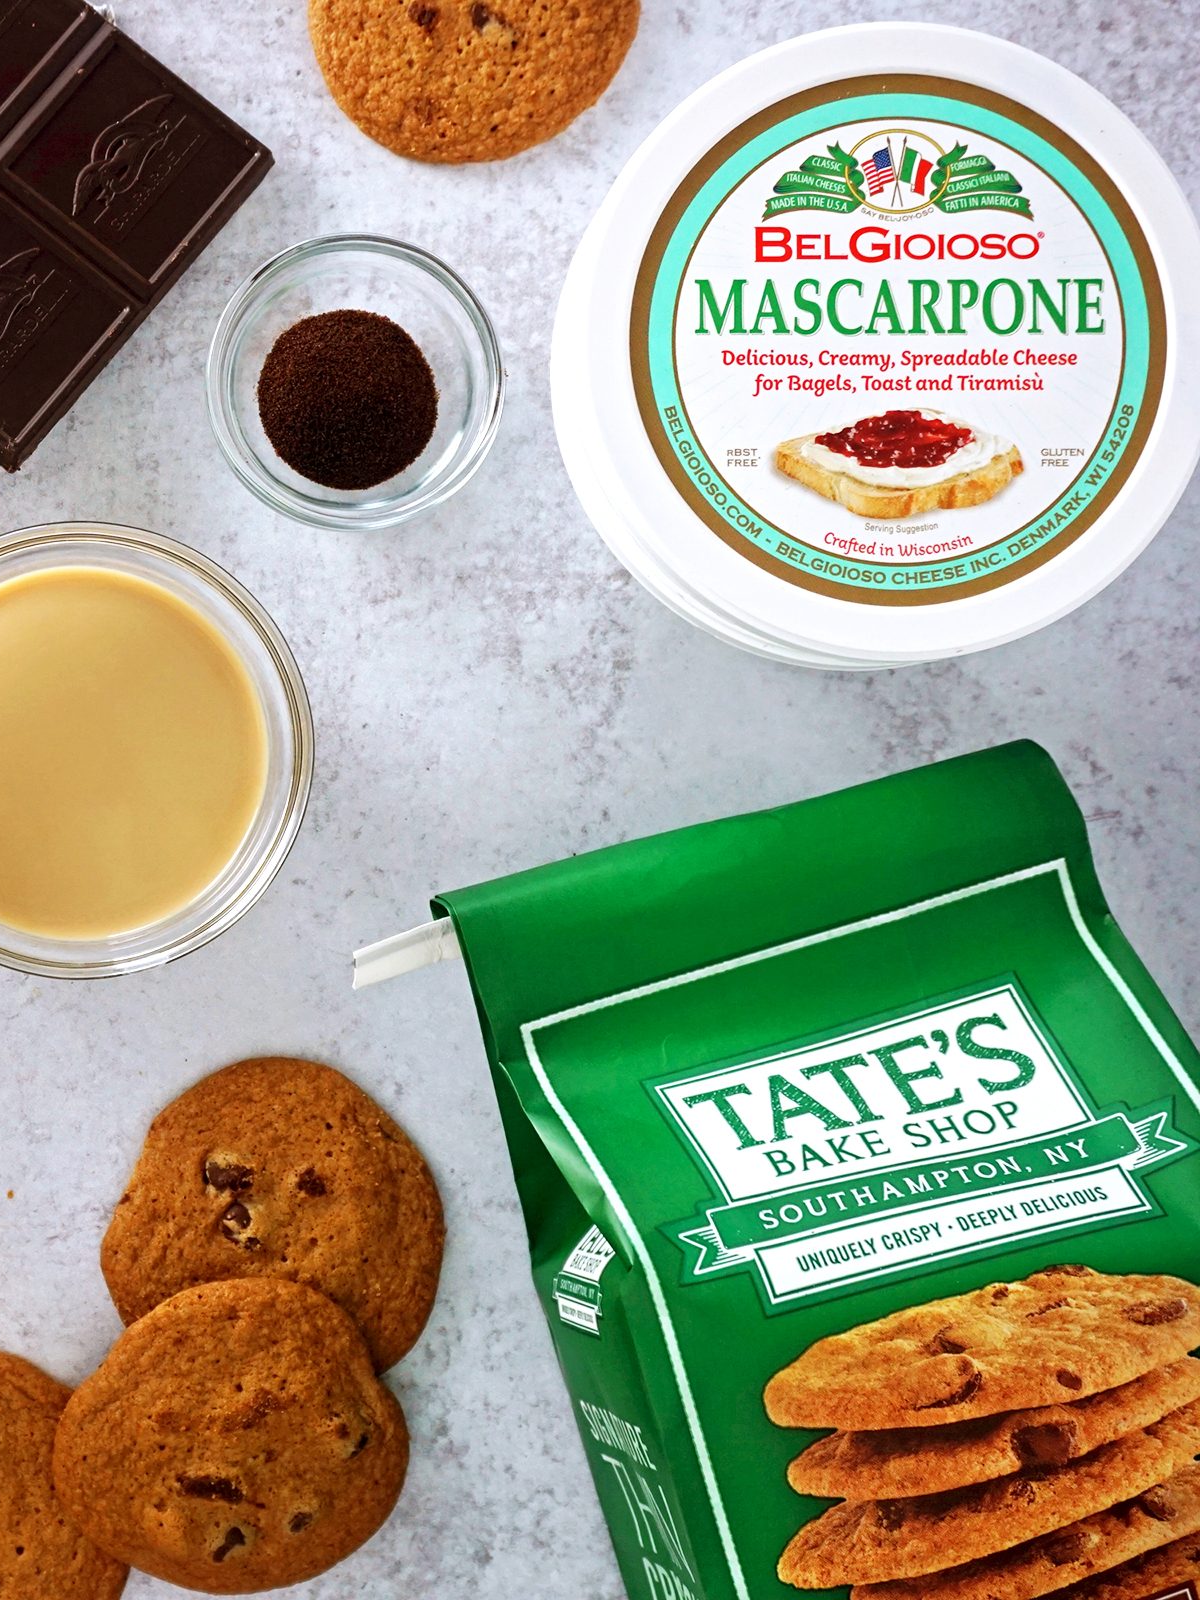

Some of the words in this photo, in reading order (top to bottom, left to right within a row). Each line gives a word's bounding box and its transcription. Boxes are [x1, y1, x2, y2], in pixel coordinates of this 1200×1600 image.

[811, 157, 842, 172] CLASSIC
[950, 156, 987, 173] FORMAGGI
[785, 174, 814, 189] ITALIAN
[815, 178, 846, 194] CHEESES
[946, 178, 979, 193] CLASSICI
[979, 173, 1010, 187] ITALIANI
[771, 196, 795, 211] MADE
[797, 196, 807, 207] IN
[808, 197, 825, 208] THE
[945, 198, 967, 211] FATTI
[969, 197, 979, 207] IN
[980, 196, 1020, 208] AMERICA
[860, 207, 877, 218] SAY
[878, 207, 935, 222] BEL-JOY-OSO
[694, 278, 1106, 336] MASCARPONE
[721, 349, 813, 368] Delicious,
[818, 350, 895, 371] Creamy,
[900, 349, 1008, 371] Spreadable
[1013, 350, 1078, 366] Cheese
[752, 374, 784, 397] for
[787, 374, 857, 396] Bagels,
[861, 374, 912, 391] Toast
[916, 374, 953, 391] and
[957, 373, 1044, 391] Tiramisù
[726, 448, 758, 457] rBST
[1040, 448, 1085, 457] GLUTEN
[1041, 459, 1069, 467] FREE
[664, 405, 763, 538] BELGIOIOSO.COM
[776, 541, 886, 584] BELGIOIOSO
[891, 563, 967, 585] CHEESE
[970, 552, 1007, 574] INC.
[1007, 490, 1091, 558] DENMARK,
[1084, 464, 1108, 487] WI
[1102, 404, 1135, 463] 54208
[864, 522, 894, 535] Serving
[896, 522, 938, 535] Suggestion
[824, 532, 876, 555] Crafted
[880, 543, 894, 556] in
[897, 535, 974, 557] Wisconsin
[683, 1012, 1036, 1151] TATE'S
[764, 1130, 891, 1177] BAKE
[903, 1101, 1018, 1148] SHOP
[758, 1156, 1032, 1230] SOUTHAMPTON,
[1042, 1138, 1090, 1166] NY
[796, 1237, 879, 1273] UNIQUELY
[881, 1222, 943, 1252] CRISPY
[955, 1204, 1019, 1232] DEEPLY
[1020, 1185, 1109, 1217] DELICIOUS
